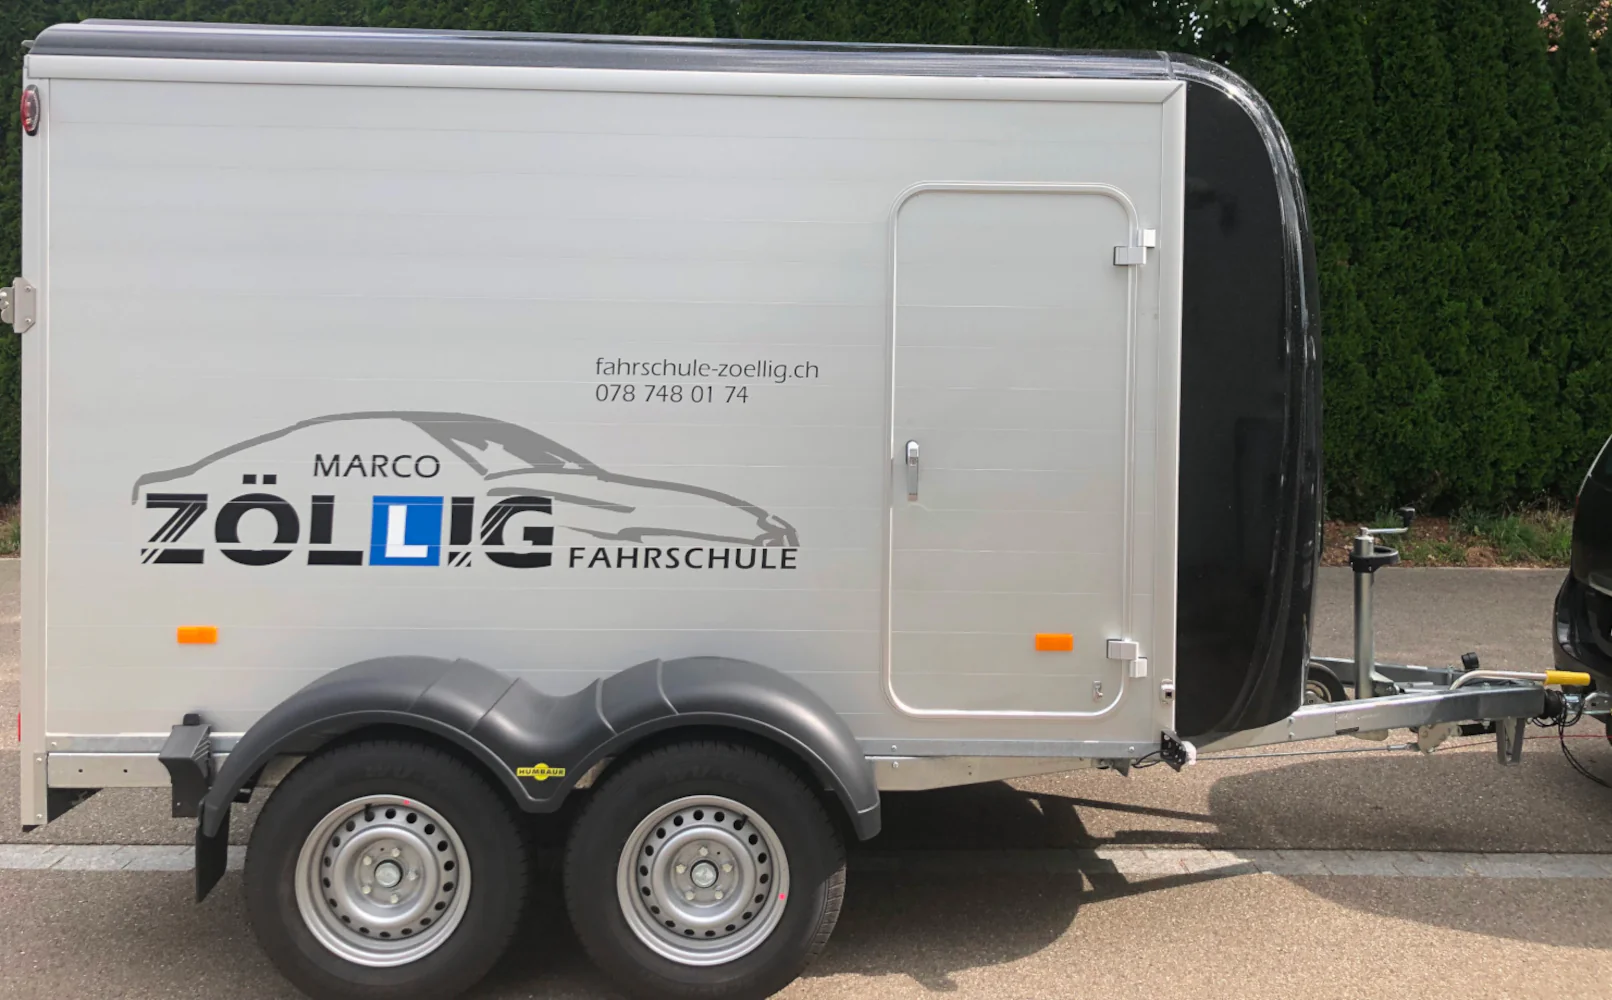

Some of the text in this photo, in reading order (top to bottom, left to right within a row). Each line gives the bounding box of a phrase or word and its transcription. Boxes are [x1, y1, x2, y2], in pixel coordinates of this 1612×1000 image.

[596, 357, 819, 383] fahrschule-zoellig.ch
[596, 384, 749, 404] 078 748 01 74
[313, 454, 440, 478] MARCO
[141, 474, 554, 569] ZÖLLIG
[569, 546, 798, 569] FAHRSCHULE
